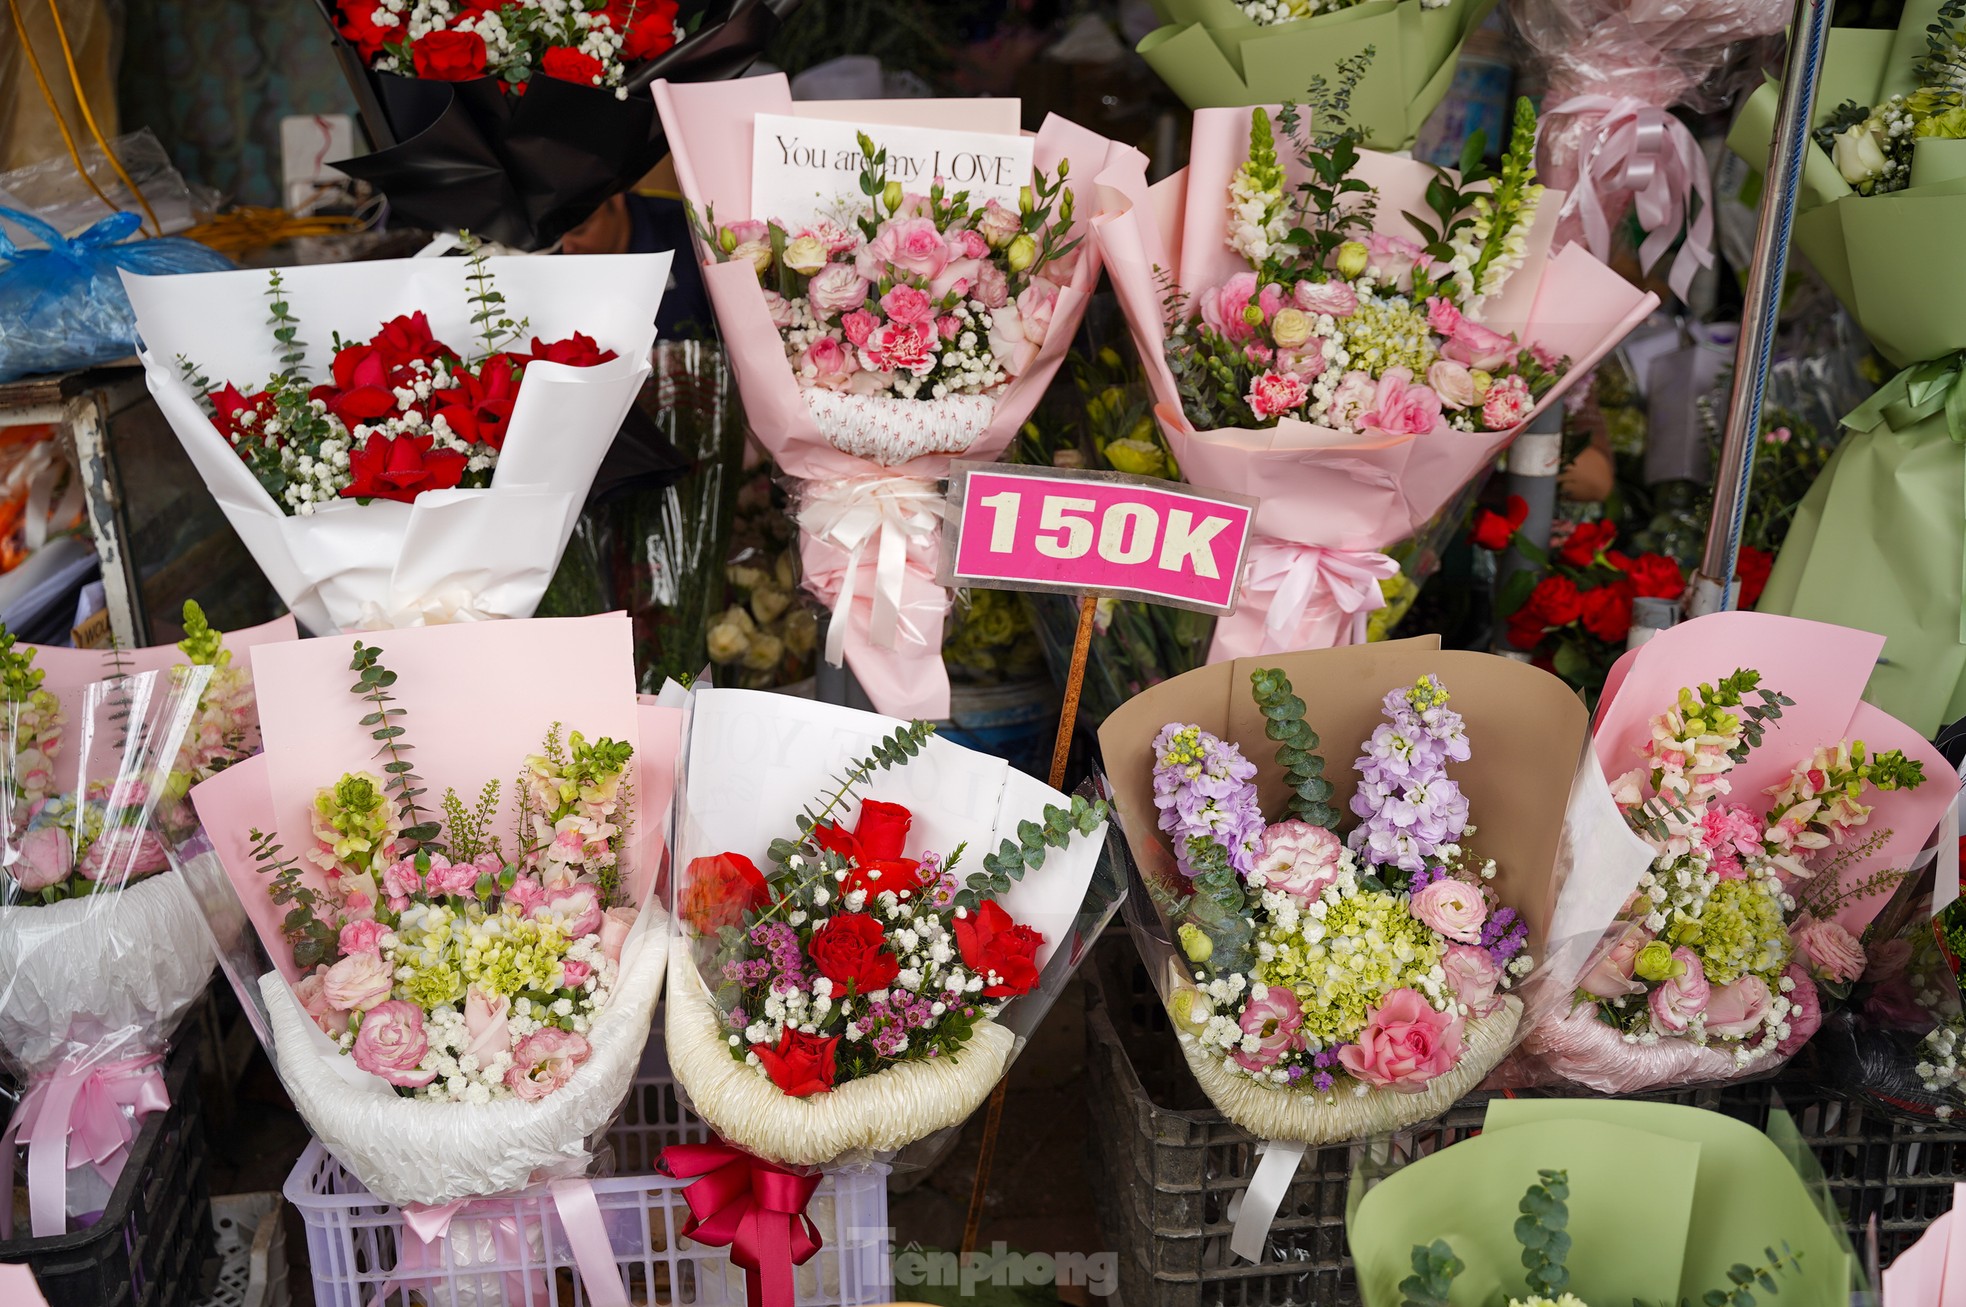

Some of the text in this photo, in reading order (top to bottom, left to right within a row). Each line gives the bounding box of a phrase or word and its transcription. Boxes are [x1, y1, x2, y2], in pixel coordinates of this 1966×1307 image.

[776, 135, 826, 168] You
[882, 154, 926, 183] my
[933, 150, 1014, 186] LOVE
[980, 491, 1234, 580] 150K
